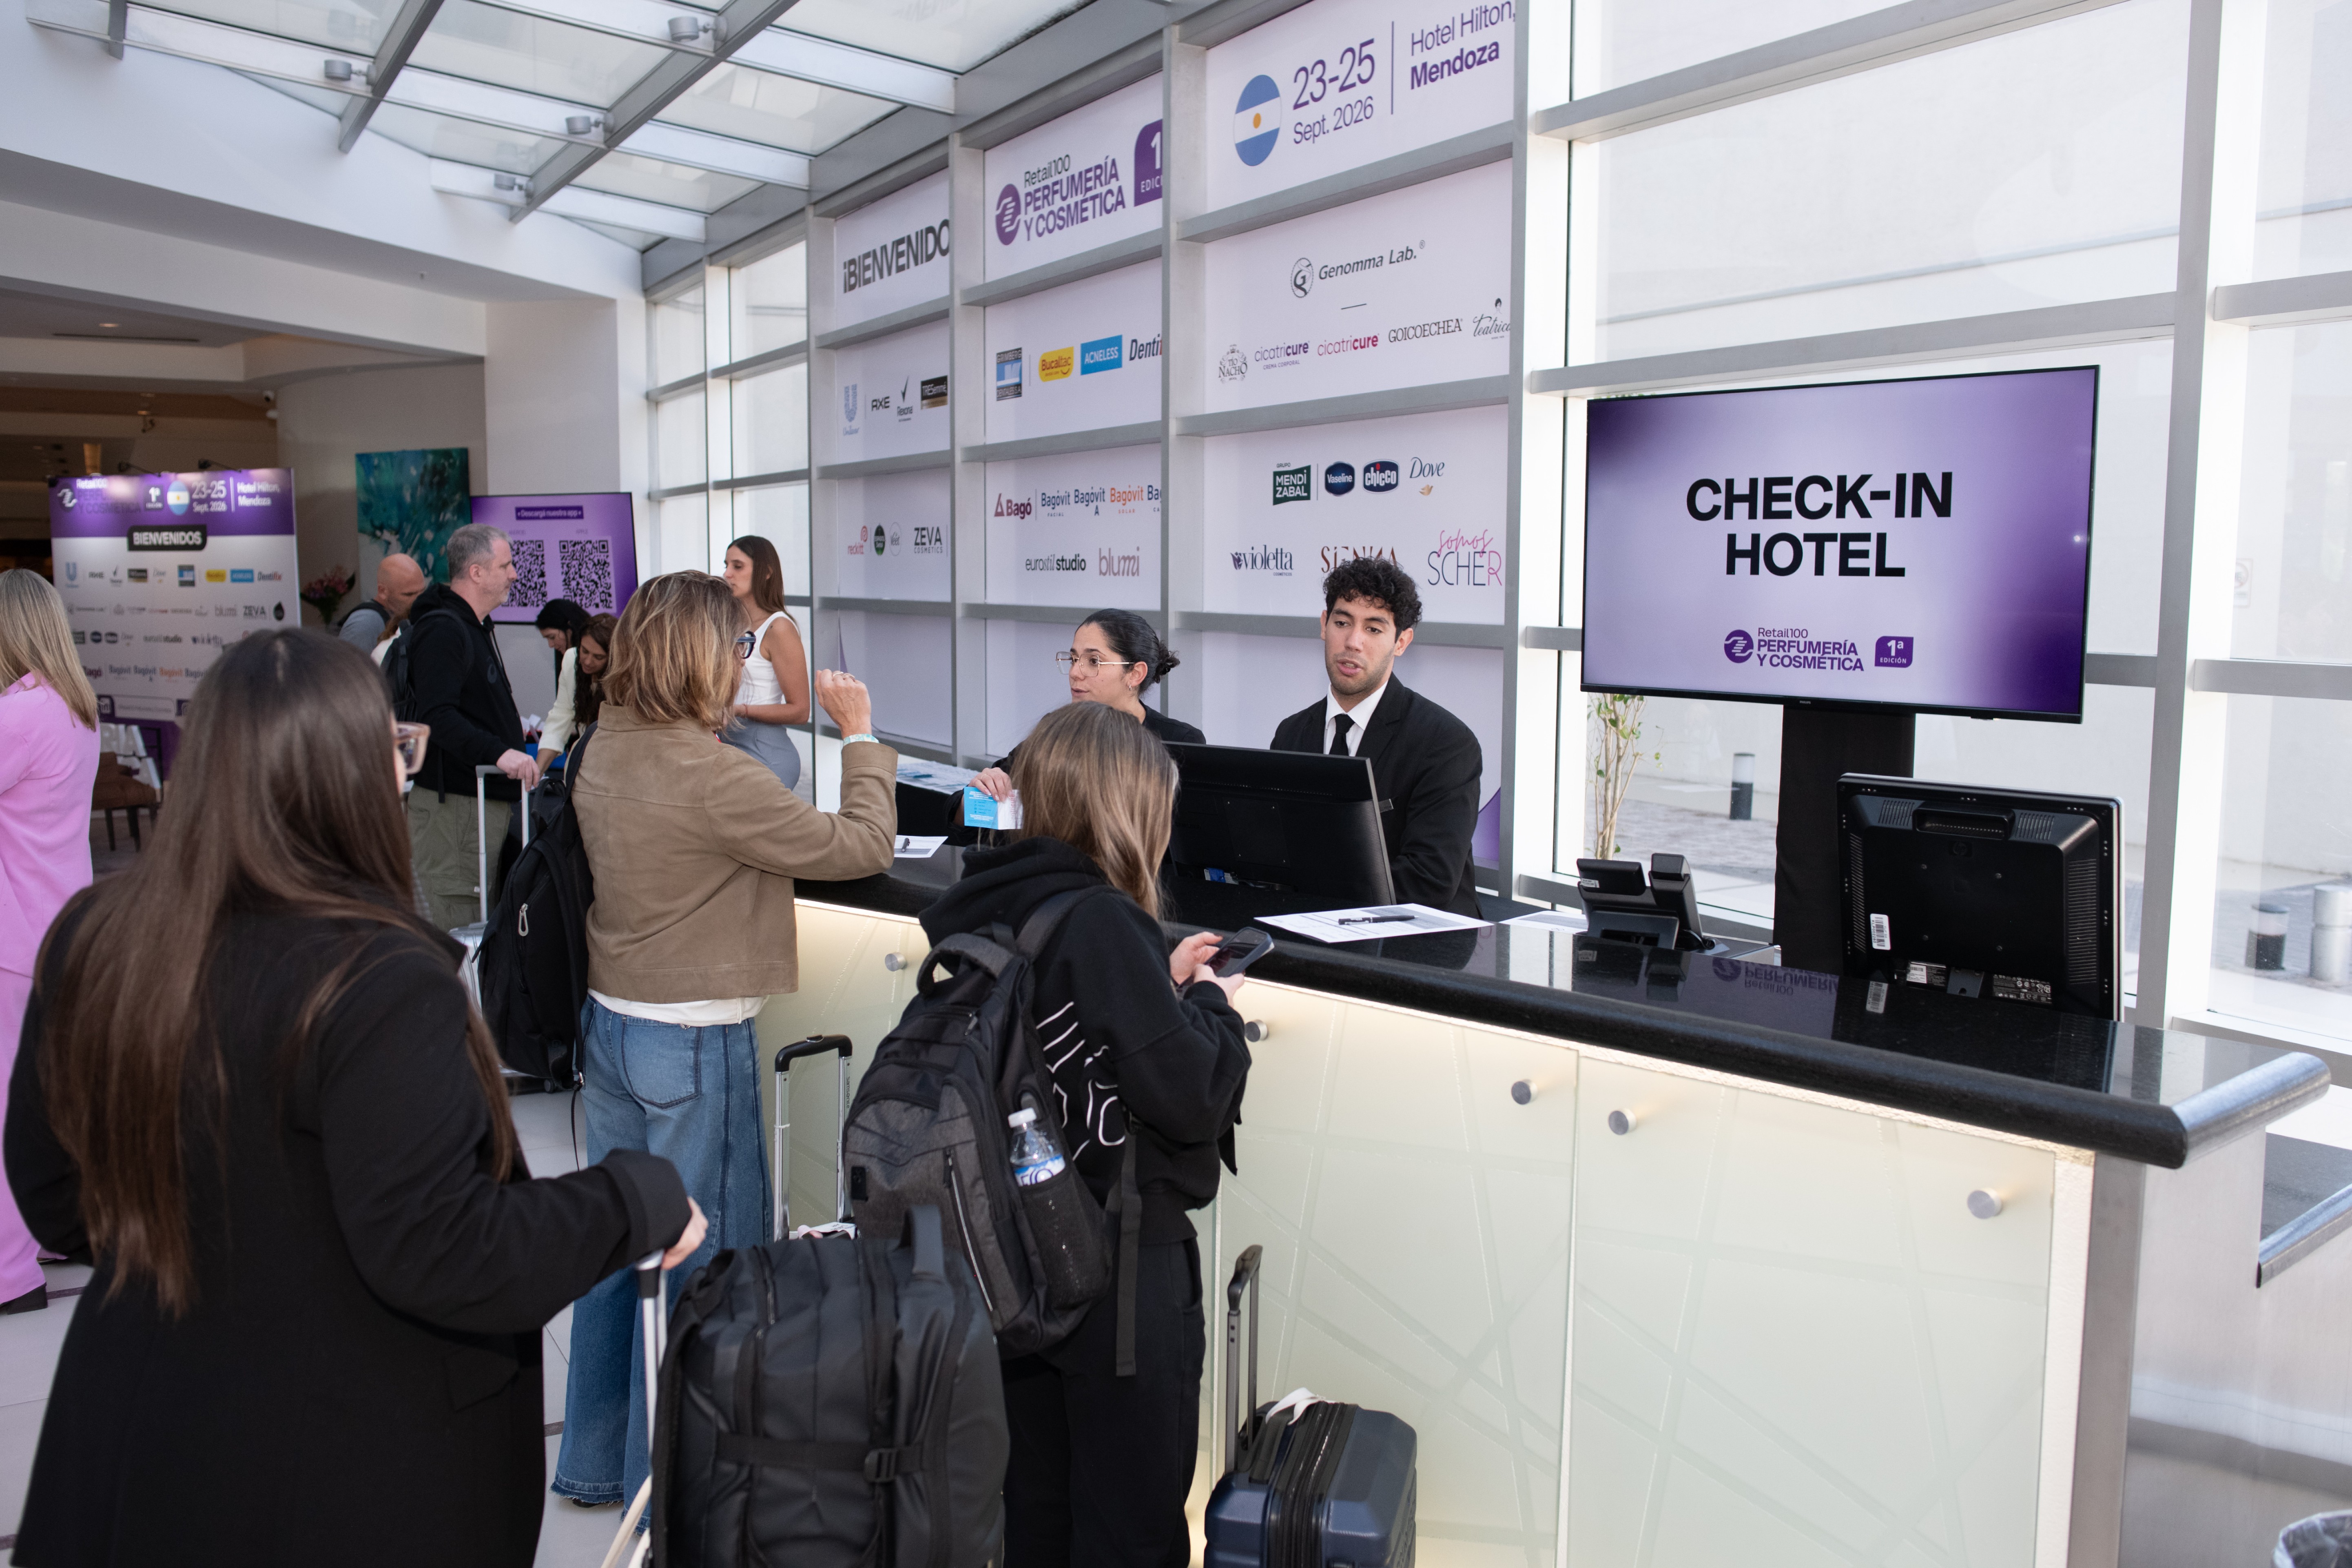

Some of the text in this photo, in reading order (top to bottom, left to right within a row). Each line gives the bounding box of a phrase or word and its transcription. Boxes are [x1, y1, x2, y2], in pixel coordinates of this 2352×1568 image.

[1411, 17, 1454, 56] Hotel
[1293, 38, 1375, 110] 23-25
[1411, 42, 1499, 89] Mendoza
[1293, 96, 1373, 144] Sept. 2026
[1024, 154, 1070, 188] Retail100
[1024, 155, 1119, 215] PERFUMERÍA
[1024, 185, 1125, 241] Y COSMÉTICA
[1319, 255, 1383, 281] Genomma
[1389, 319, 1462, 343] GOICOECHEA
[1254, 343, 1309, 362] cicatricure
[1318, 334, 1379, 356] cicatricure
[1084, 346, 1118, 364] ACNELESS
[1218, 363, 1247, 378] NACHO
[872, 396, 890, 411] AXE
[1365, 463, 1397, 487] chicco
[1409, 456, 1445, 478] Dove
[237, 482, 255, 493] Hotel
[1327, 473, 1352, 483] Vaseline
[192, 480, 227, 499] 23-25
[1074, 487, 1105, 507] Bagóvit
[1110, 485, 1143, 506] Bagóvit
[1276, 486, 1307, 497] ZABAL
[1686, 471, 1953, 521] CHECK-IN
[193, 501, 227, 514] Sept. 2026
[238, 495, 271, 506] Mendoza
[1006, 498, 1032, 519] Bagó
[1041, 490, 1070, 509] Bagóvit
[1094, 505, 1099, 516] A
[133, 531, 203, 545] BIENVENIDOS
[914, 527, 942, 546] ZEVA
[1437, 529, 1493, 558] somos
[848, 542, 864, 555] reckitt
[1241, 545, 1293, 570] violetta
[1725, 532, 1906, 578] HOTEL
[1099, 546, 1140, 576] blumi
[1428, 551, 1502, 586] SCHER
[258, 571, 281, 581] Dentifix
[243, 605, 266, 616] ZEVA
[1757, 627, 1808, 640] Retail100
[1757, 638, 1858, 656] PERFUMERÍA
[1757, 653, 1864, 672] Y COSMÉTICA
[1880, 655, 1907, 664] EDICIÓN
